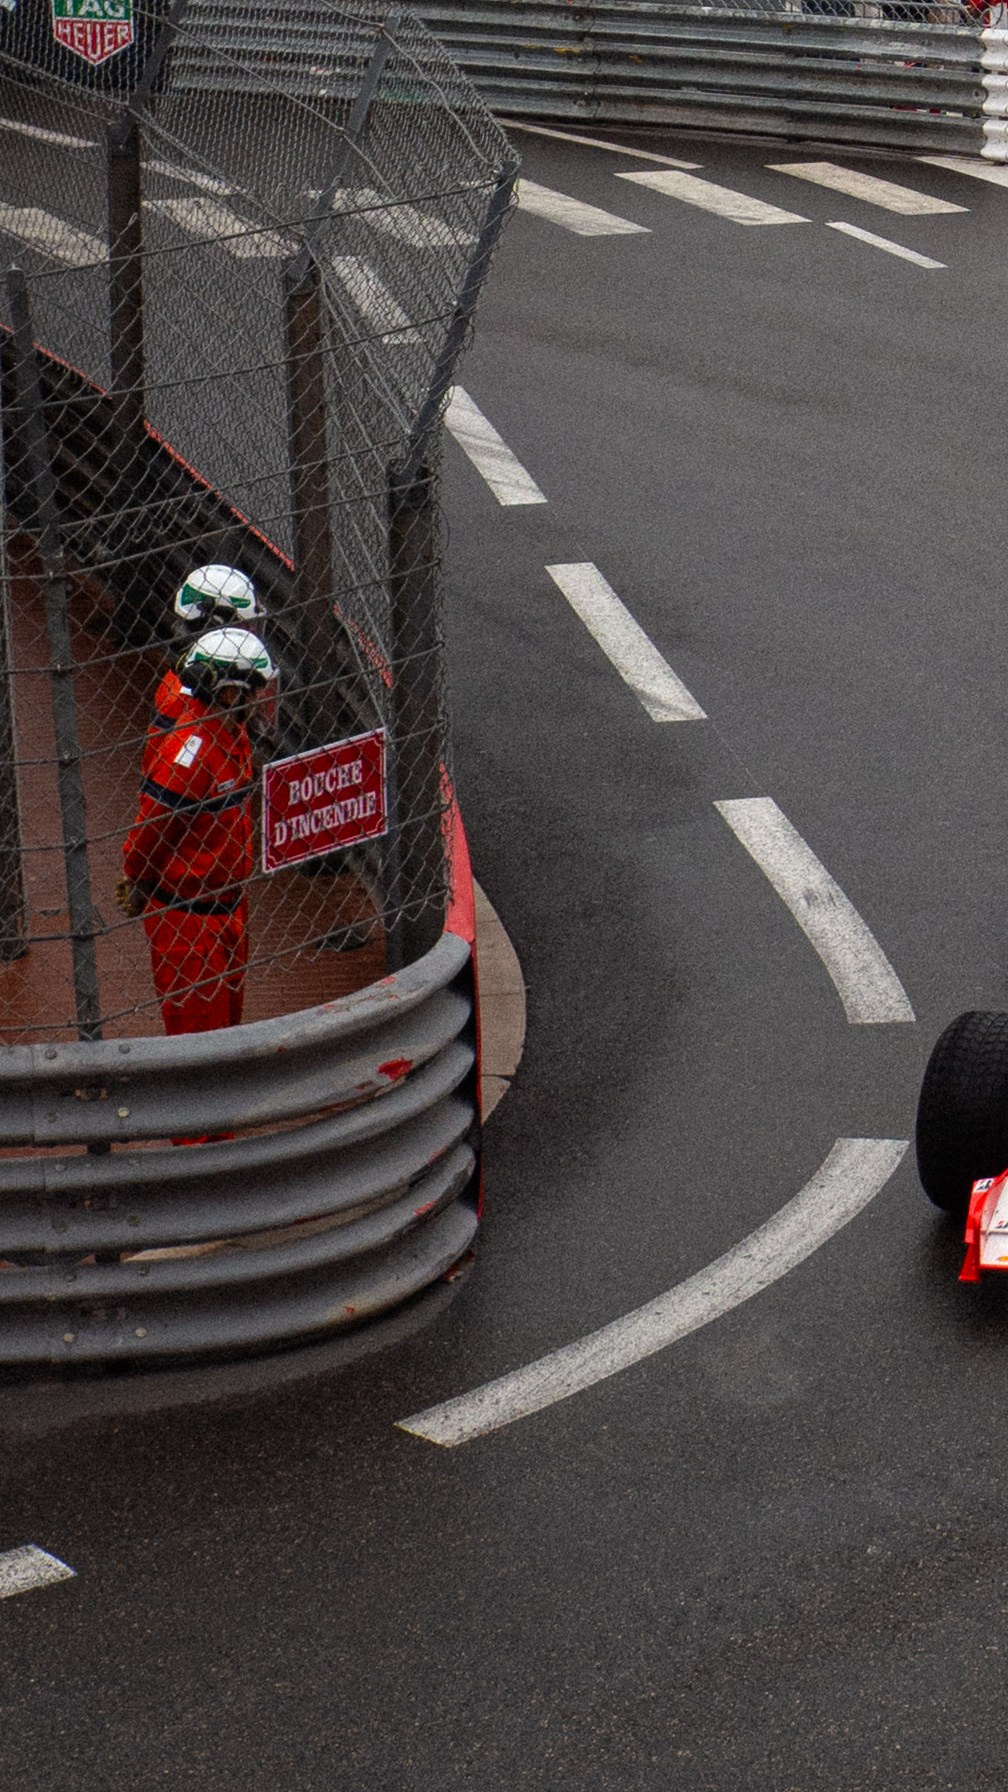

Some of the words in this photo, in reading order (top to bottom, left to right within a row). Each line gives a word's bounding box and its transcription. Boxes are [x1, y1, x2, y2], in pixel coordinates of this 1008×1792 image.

[57, 21, 130, 60] HEUER
[288, 759, 363, 806] BOUCHE
[274, 790, 377, 847] D'INCENDIE
